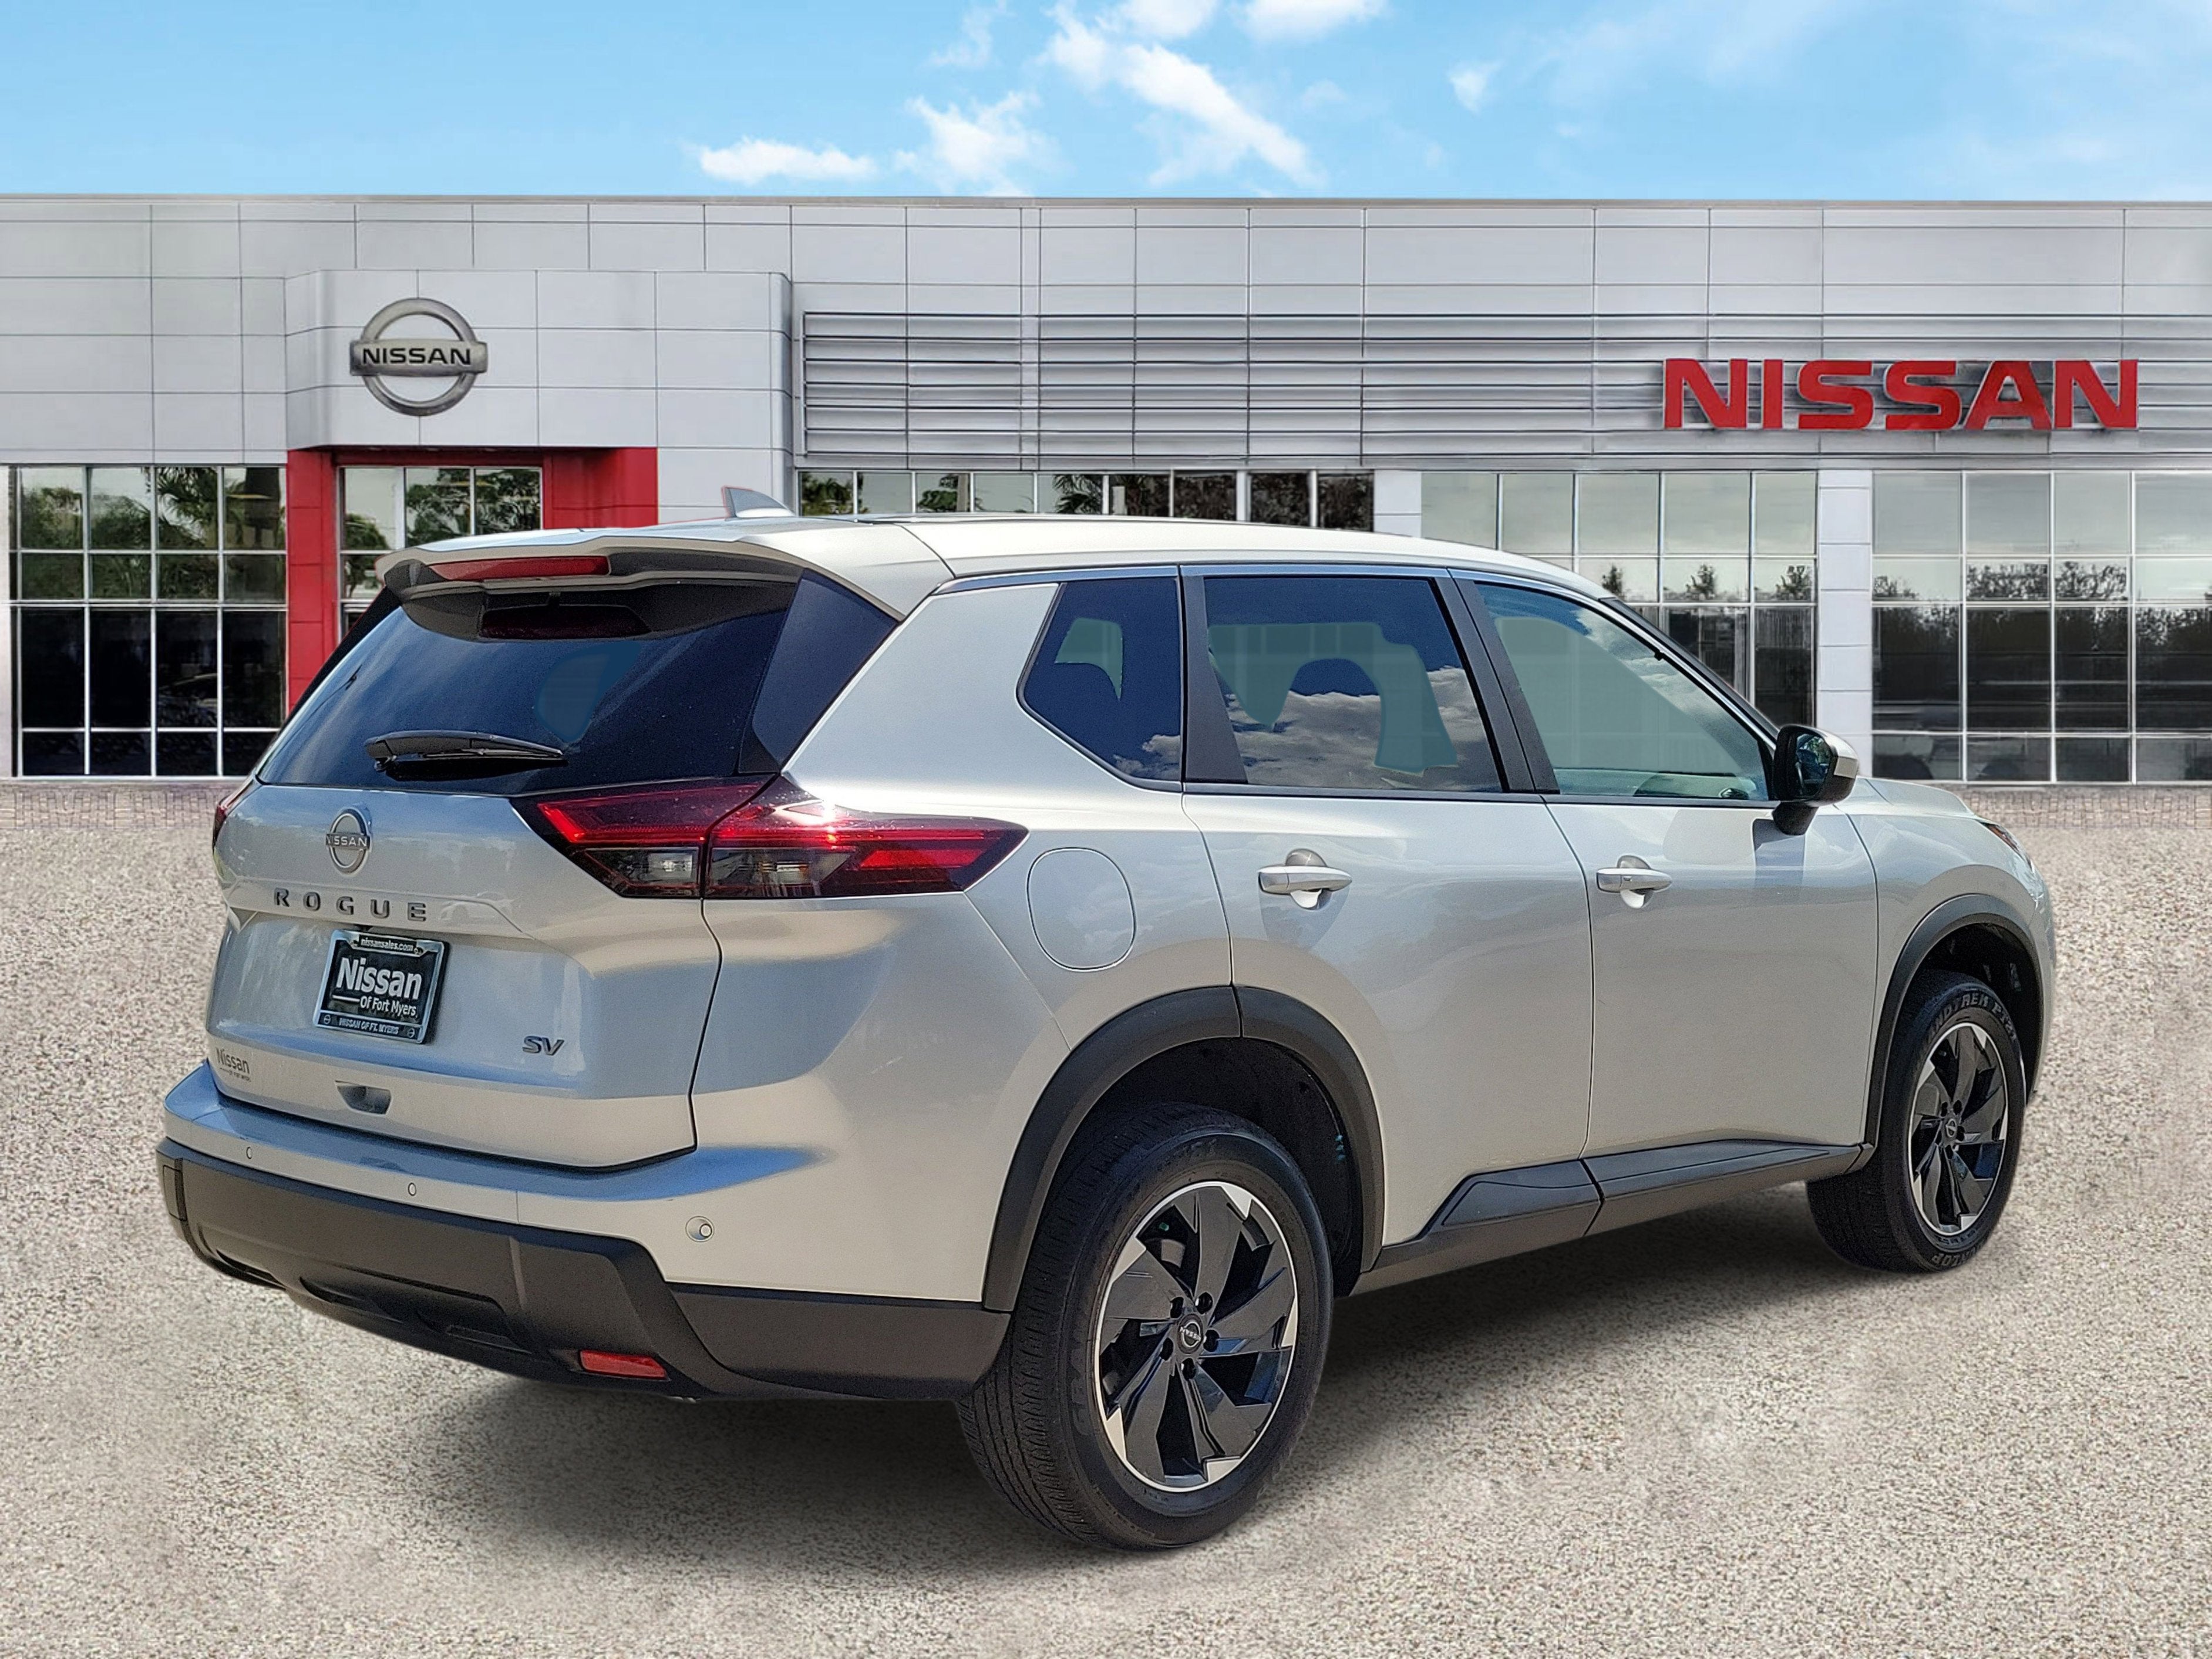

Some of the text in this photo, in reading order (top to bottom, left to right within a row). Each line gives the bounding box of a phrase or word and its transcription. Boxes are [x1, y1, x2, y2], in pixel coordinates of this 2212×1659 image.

[362, 348, 472, 366] NISSAN
[1663, 358, 2139, 430] NISSAN
[326, 834, 368, 847] NISSAN
[274, 887, 427, 922] ROGUE
[361, 937, 414, 951] nissansales.com
[336, 957, 423, 1000] Nissan
[360, 995, 372, 1009] Of
[372, 997, 390, 1012] Fort
[338, 1017, 361, 1029] NISSAN
[361, 1021, 369, 1030] OF
[378, 1024, 399, 1035] MYERS
[522, 1035, 565, 1056] SV
[215, 1046, 250, 1075] Nissan
